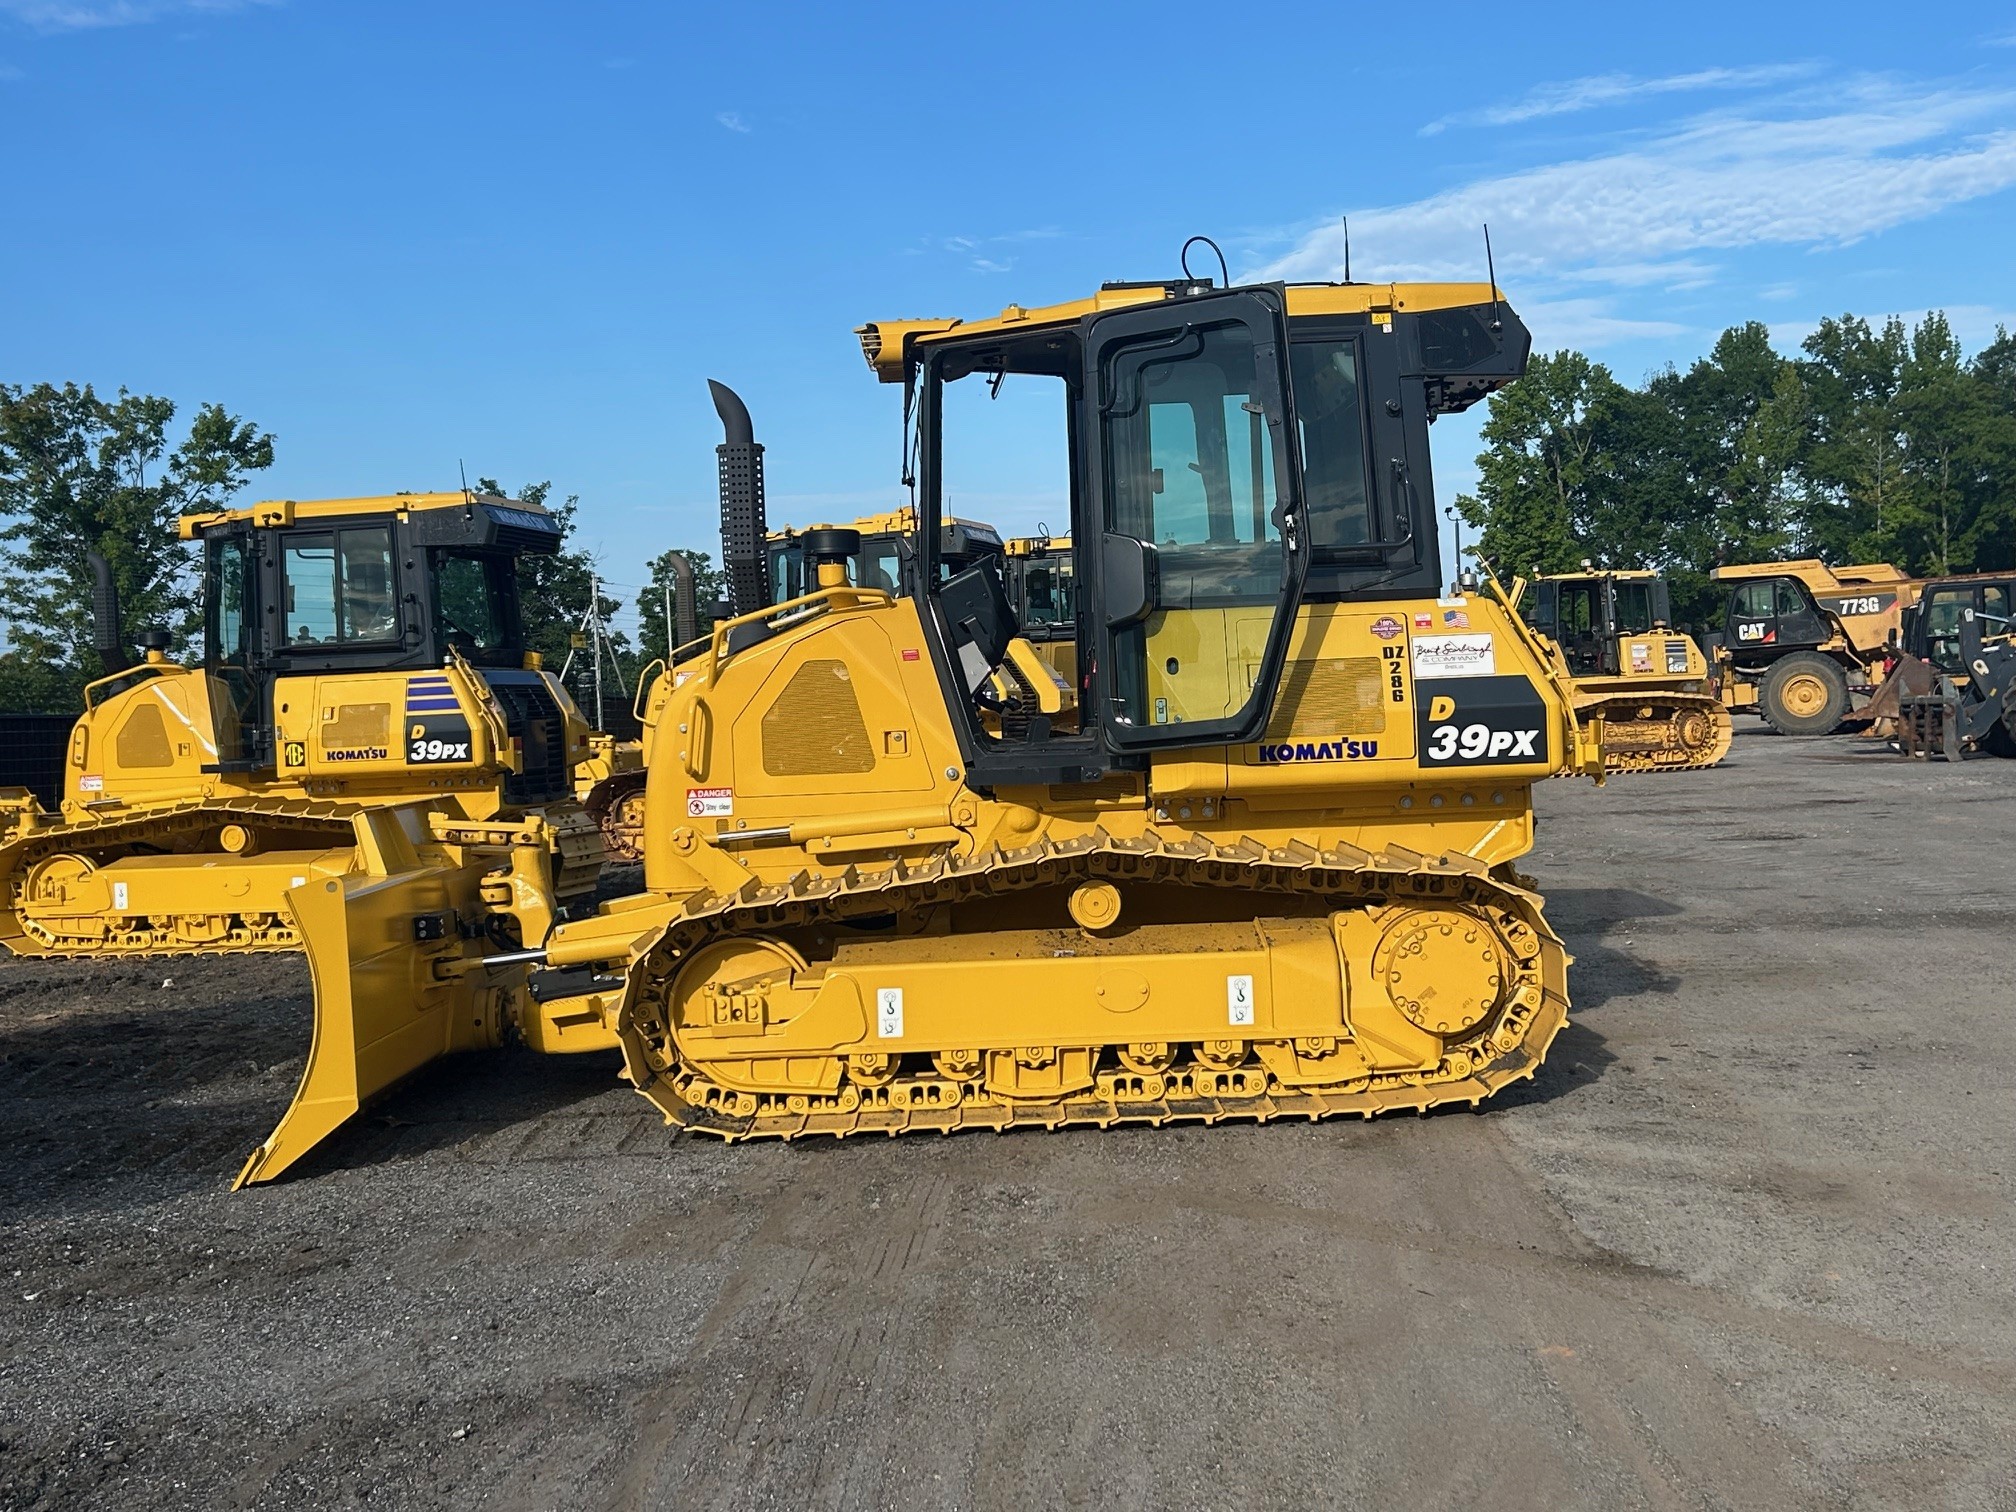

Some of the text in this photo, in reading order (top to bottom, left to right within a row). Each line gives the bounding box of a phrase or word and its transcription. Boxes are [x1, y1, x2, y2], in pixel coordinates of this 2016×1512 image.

[1839, 597, 1880, 614] 773G
[1738, 622, 1766, 641] CAT
[1431, 655, 1478, 663] COMPANY
[1428, 695, 1456, 722] D
[410, 724, 426, 739] D
[410, 740, 469, 761] 39PX
[1259, 737, 1378, 762] KOMATSU
[1428, 723, 1540, 760] 39PX
[285, 743, 304, 766] TEC
[327, 747, 387, 761] KOMATSU
[697, 789, 732, 798] DANGER
